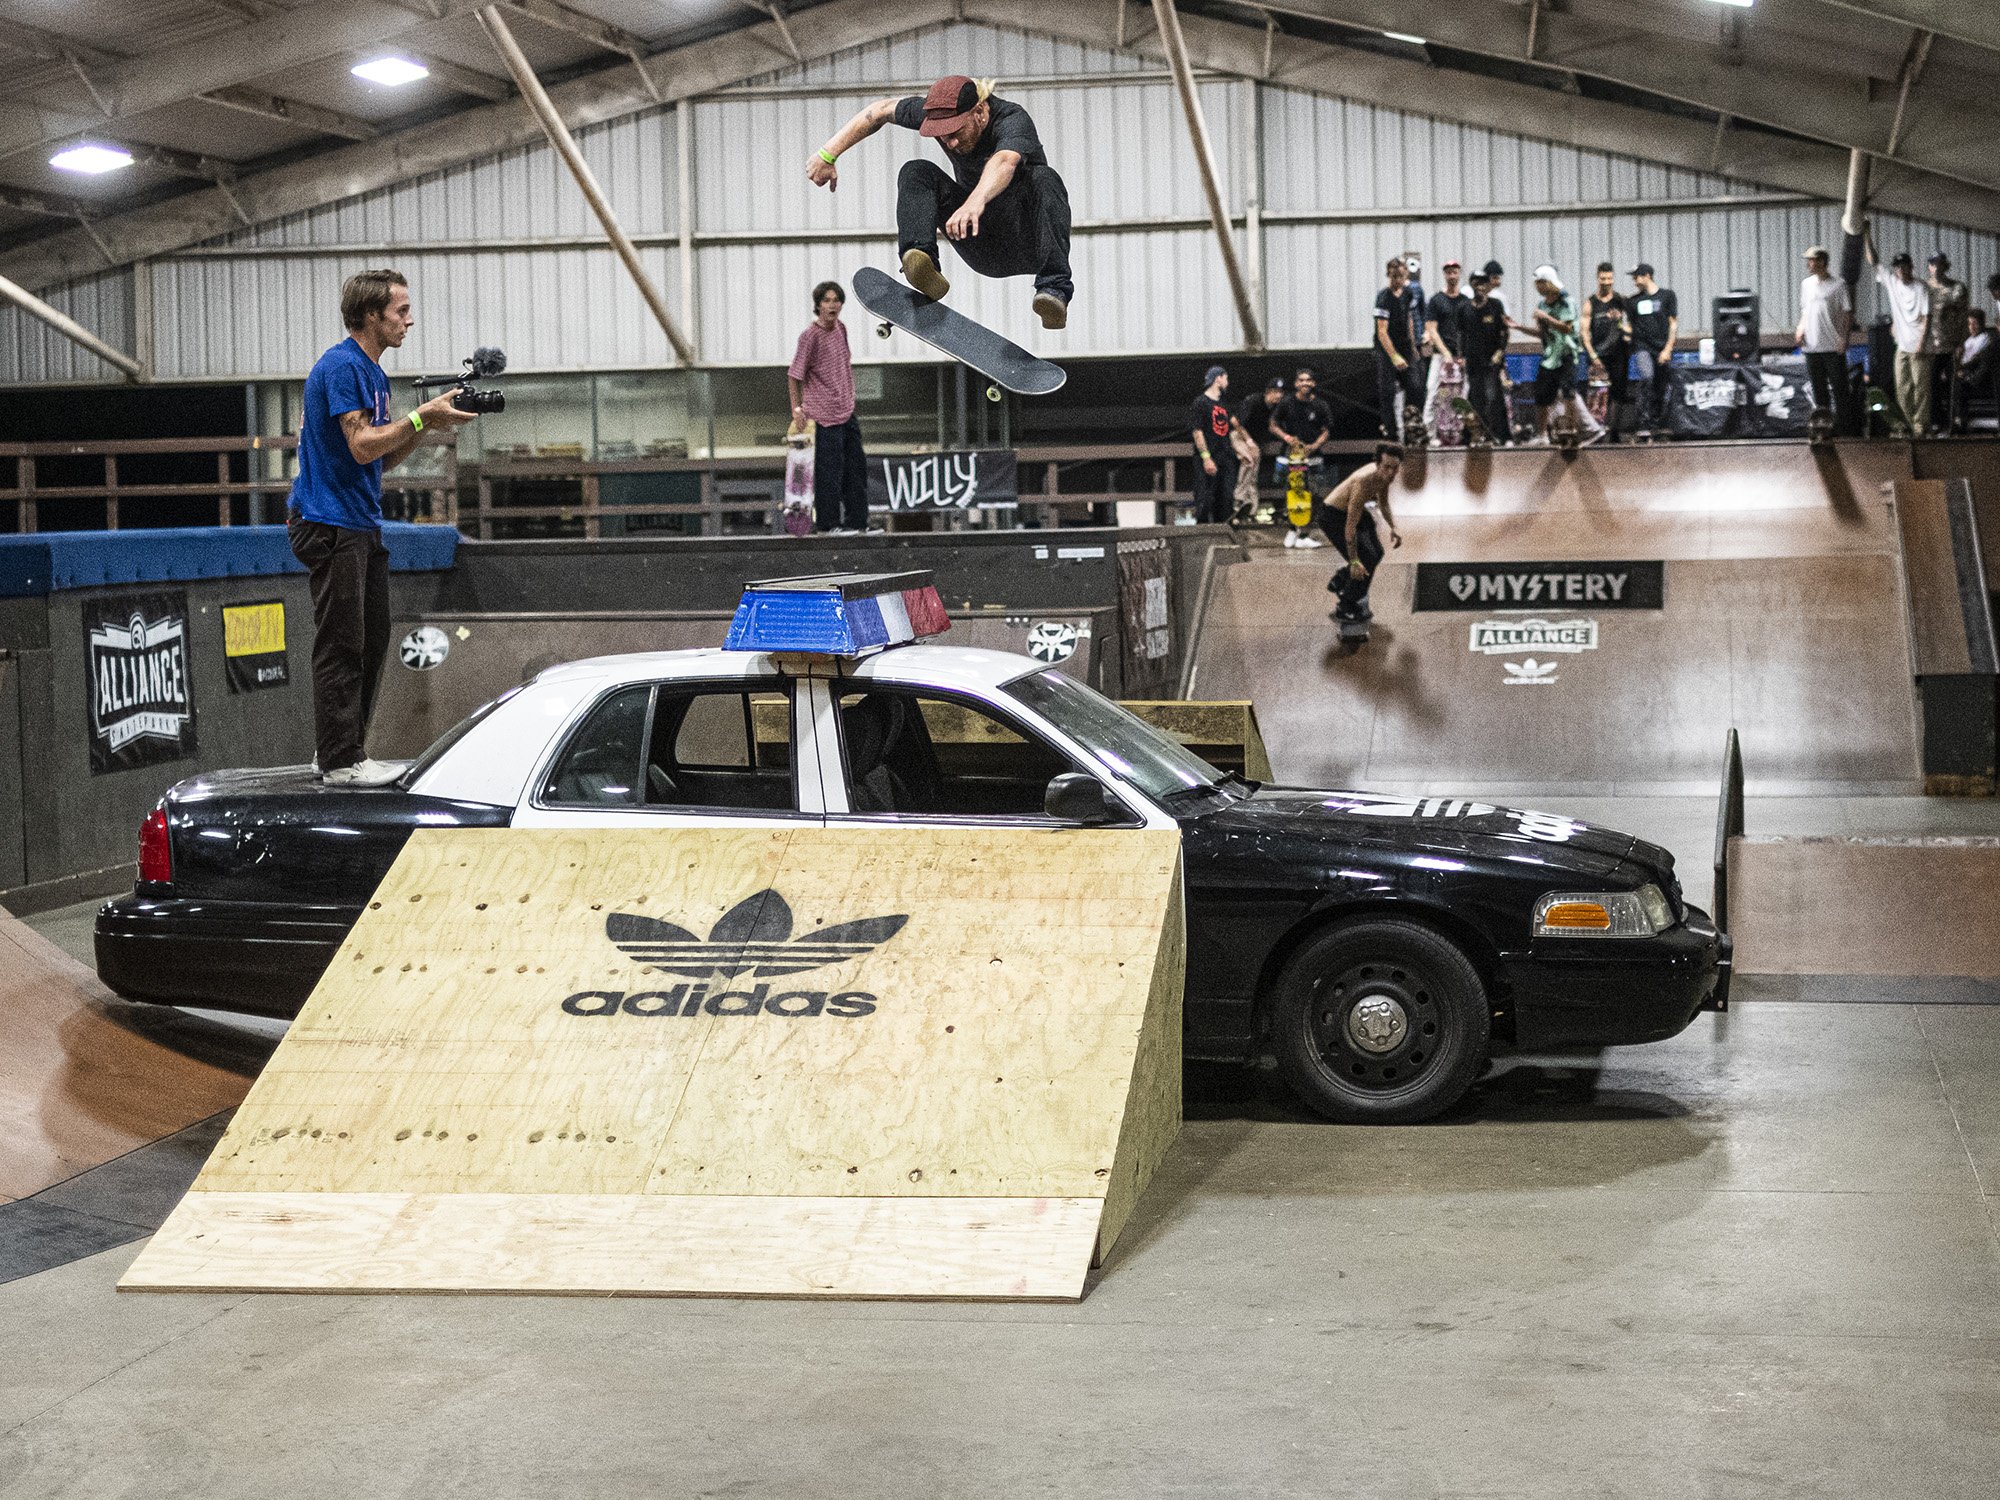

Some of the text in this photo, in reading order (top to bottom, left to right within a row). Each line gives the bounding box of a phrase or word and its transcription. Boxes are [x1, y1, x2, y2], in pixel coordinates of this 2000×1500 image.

[883, 453, 978, 510] WILLY
[1481, 628, 1588, 645] ALLIANCE
[101, 646, 184, 716] ALLIANCE
[561, 983, 878, 1018] adidas
